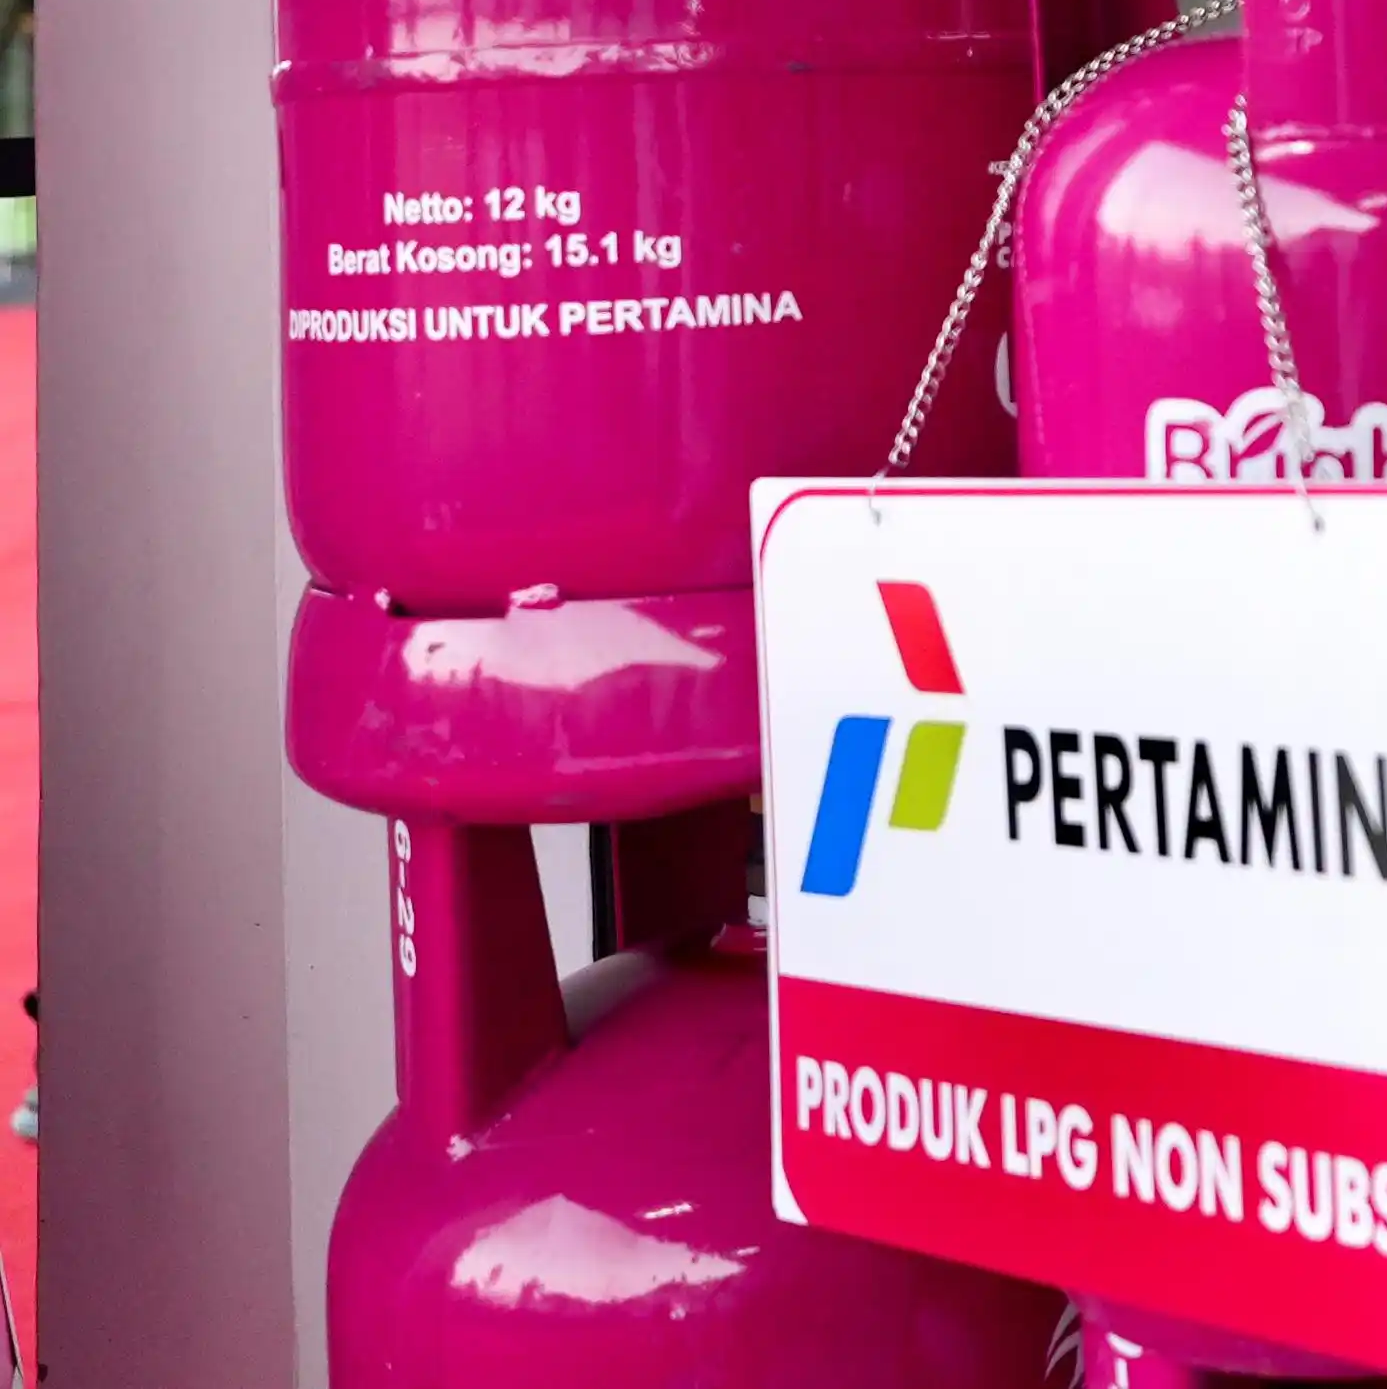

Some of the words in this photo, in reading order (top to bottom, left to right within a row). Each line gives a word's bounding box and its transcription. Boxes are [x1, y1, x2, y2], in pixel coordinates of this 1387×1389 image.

[383, 192, 474, 225] Netto:
[484, 189, 526, 221] 12
[535, 186, 581, 225] kg
[328, 243, 389, 276] Berat
[398, 240, 533, 276] Kosong:
[545, 233, 619, 268] 15.1
[634, 231, 682, 268] kg
[288, 307, 417, 343] DIPRODUKSI
[424, 304, 549, 341] UNTUK
[559, 291, 803, 336] PERTAMINA
[392, 819, 417, 977] 6-29
[795, 1054, 990, 1169] PRODUK
[1001, 1092, 1097, 1193] LPG
[1110, 1111, 1244, 1223] NON
